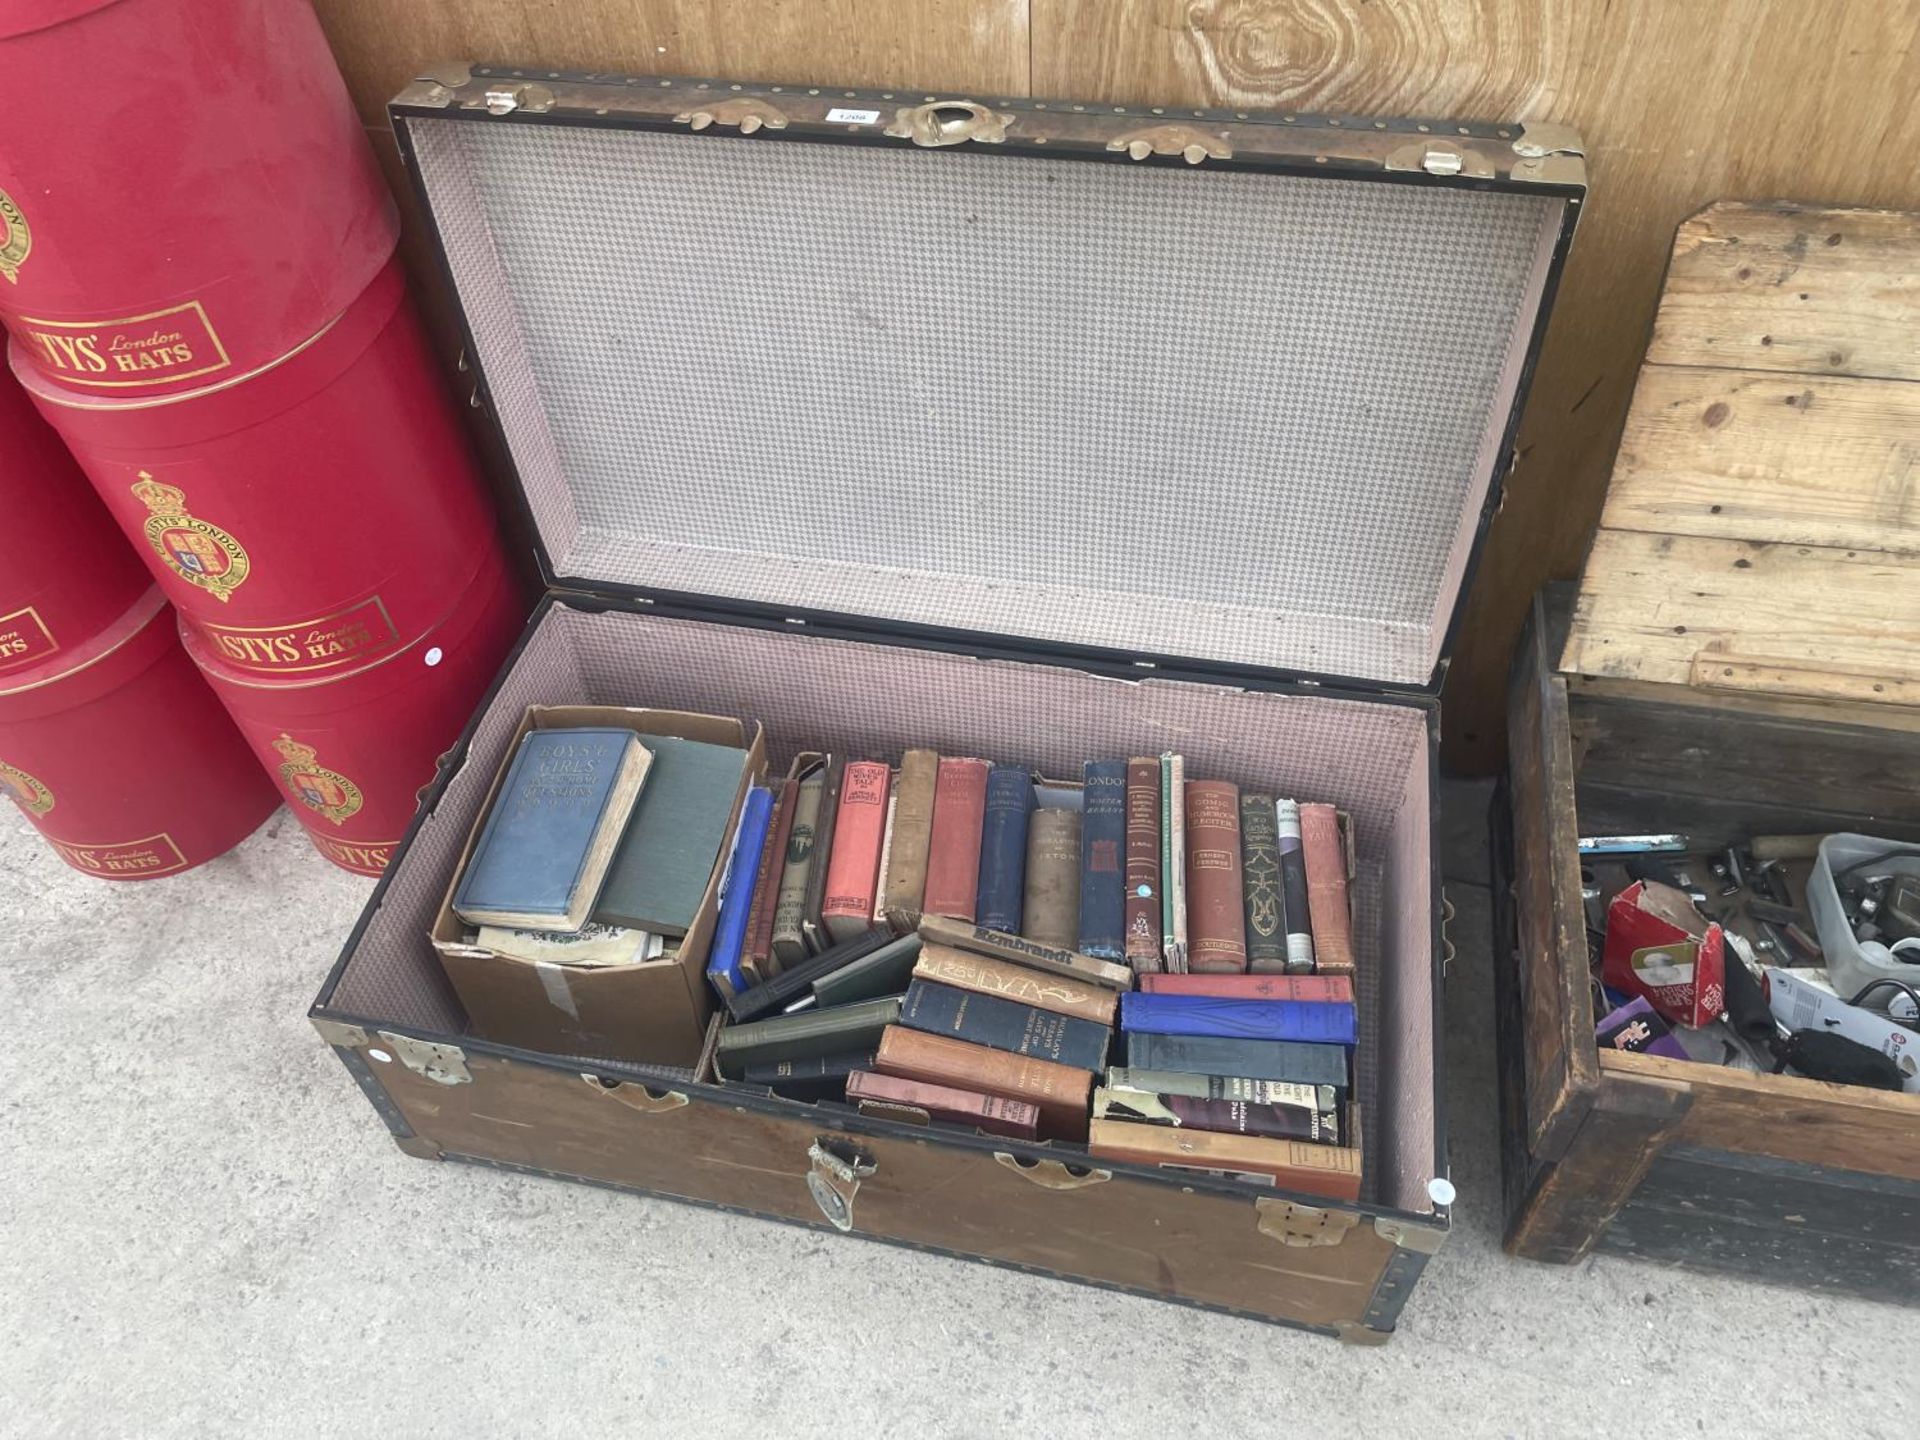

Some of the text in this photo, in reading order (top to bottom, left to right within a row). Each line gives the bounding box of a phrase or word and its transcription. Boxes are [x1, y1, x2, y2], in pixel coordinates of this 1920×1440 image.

[109, 331, 183, 352] London
[113, 342, 193, 372] HATS
[188, 518, 244, 560] LONDON
[305, 631, 372, 660] HATS
[867, 768, 883, 776] OLD
[1195, 798, 1229, 808] COMIC
[105, 855, 161, 870] HATS
[973, 928, 1074, 965] Rembrandt
